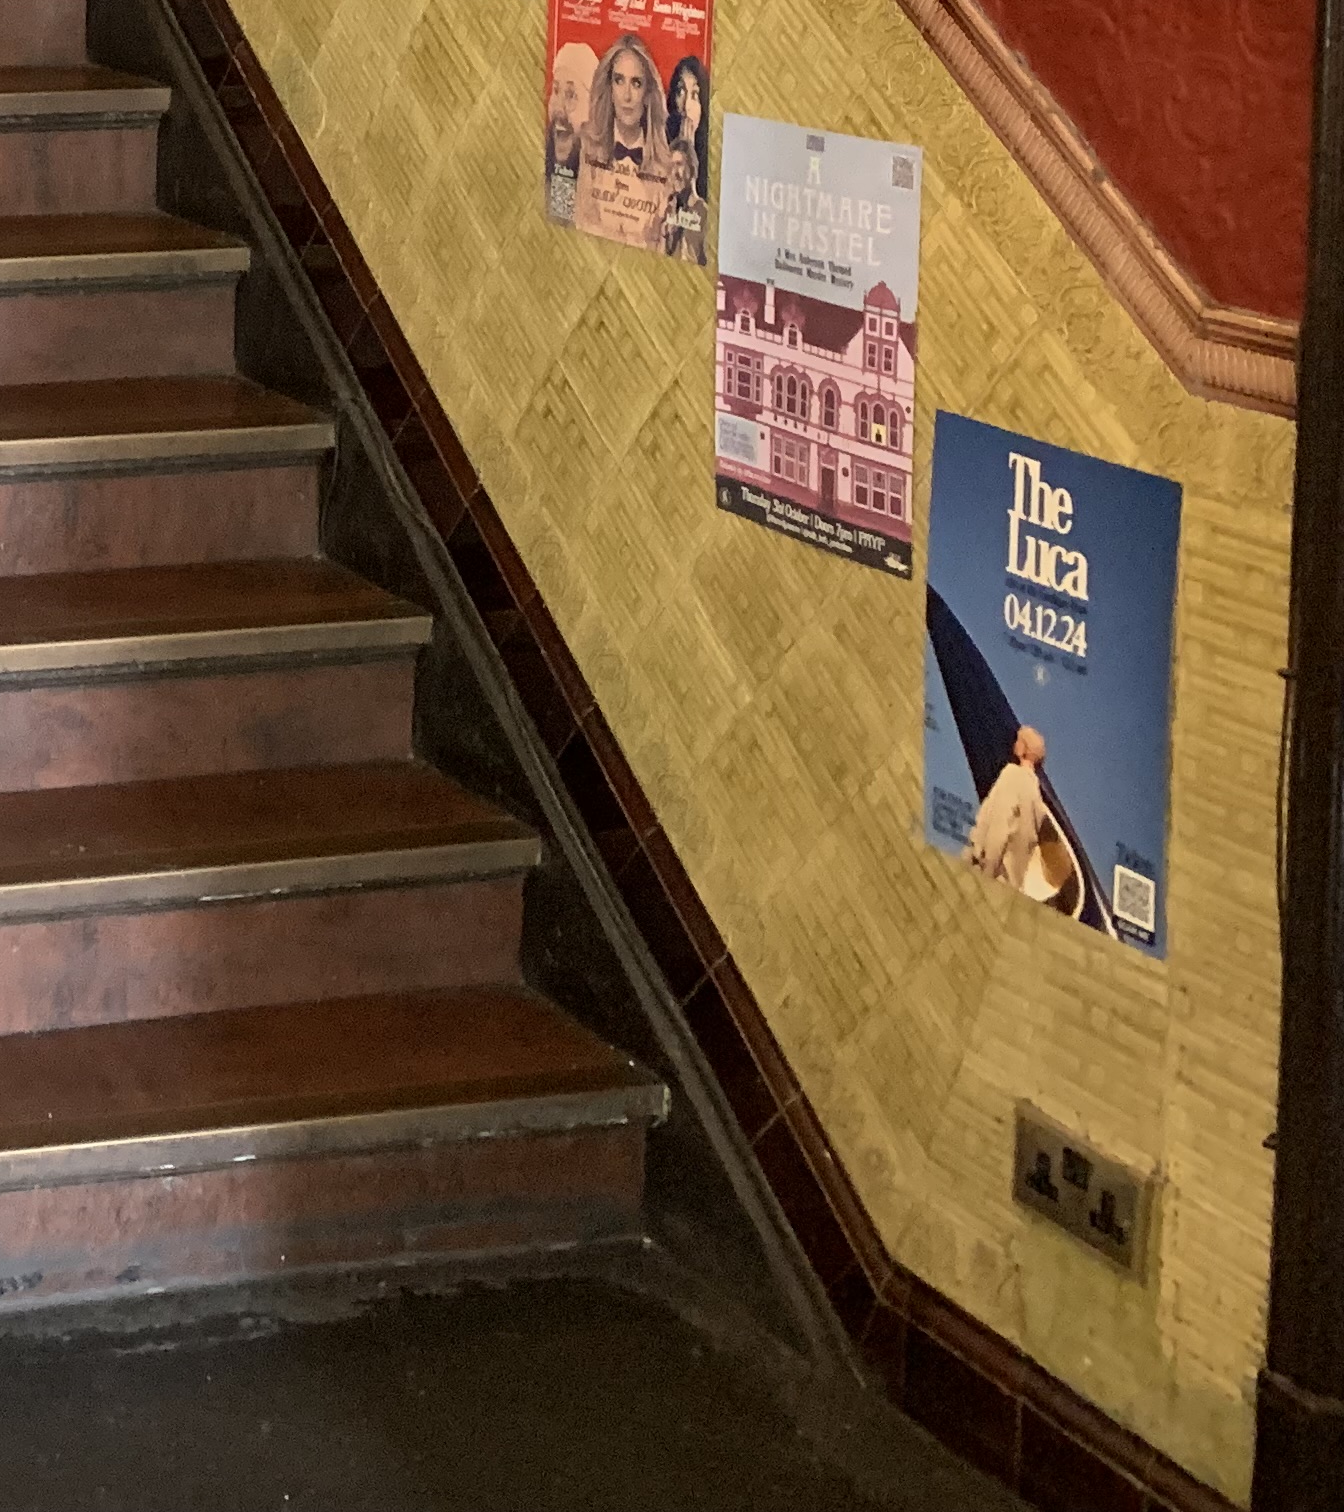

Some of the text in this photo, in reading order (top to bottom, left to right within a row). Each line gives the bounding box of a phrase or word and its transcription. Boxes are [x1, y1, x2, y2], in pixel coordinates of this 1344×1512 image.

[808, 156, 821, 185] A
[746, 174, 892, 235] NIGHTMARE
[751, 209, 777, 240] IN
[787, 216, 882, 267] PASTEL
[1008, 451, 1074, 535] The
[1006, 509, 1089, 601] Luca
[1004, 593, 1088, 658] 04.12.24
